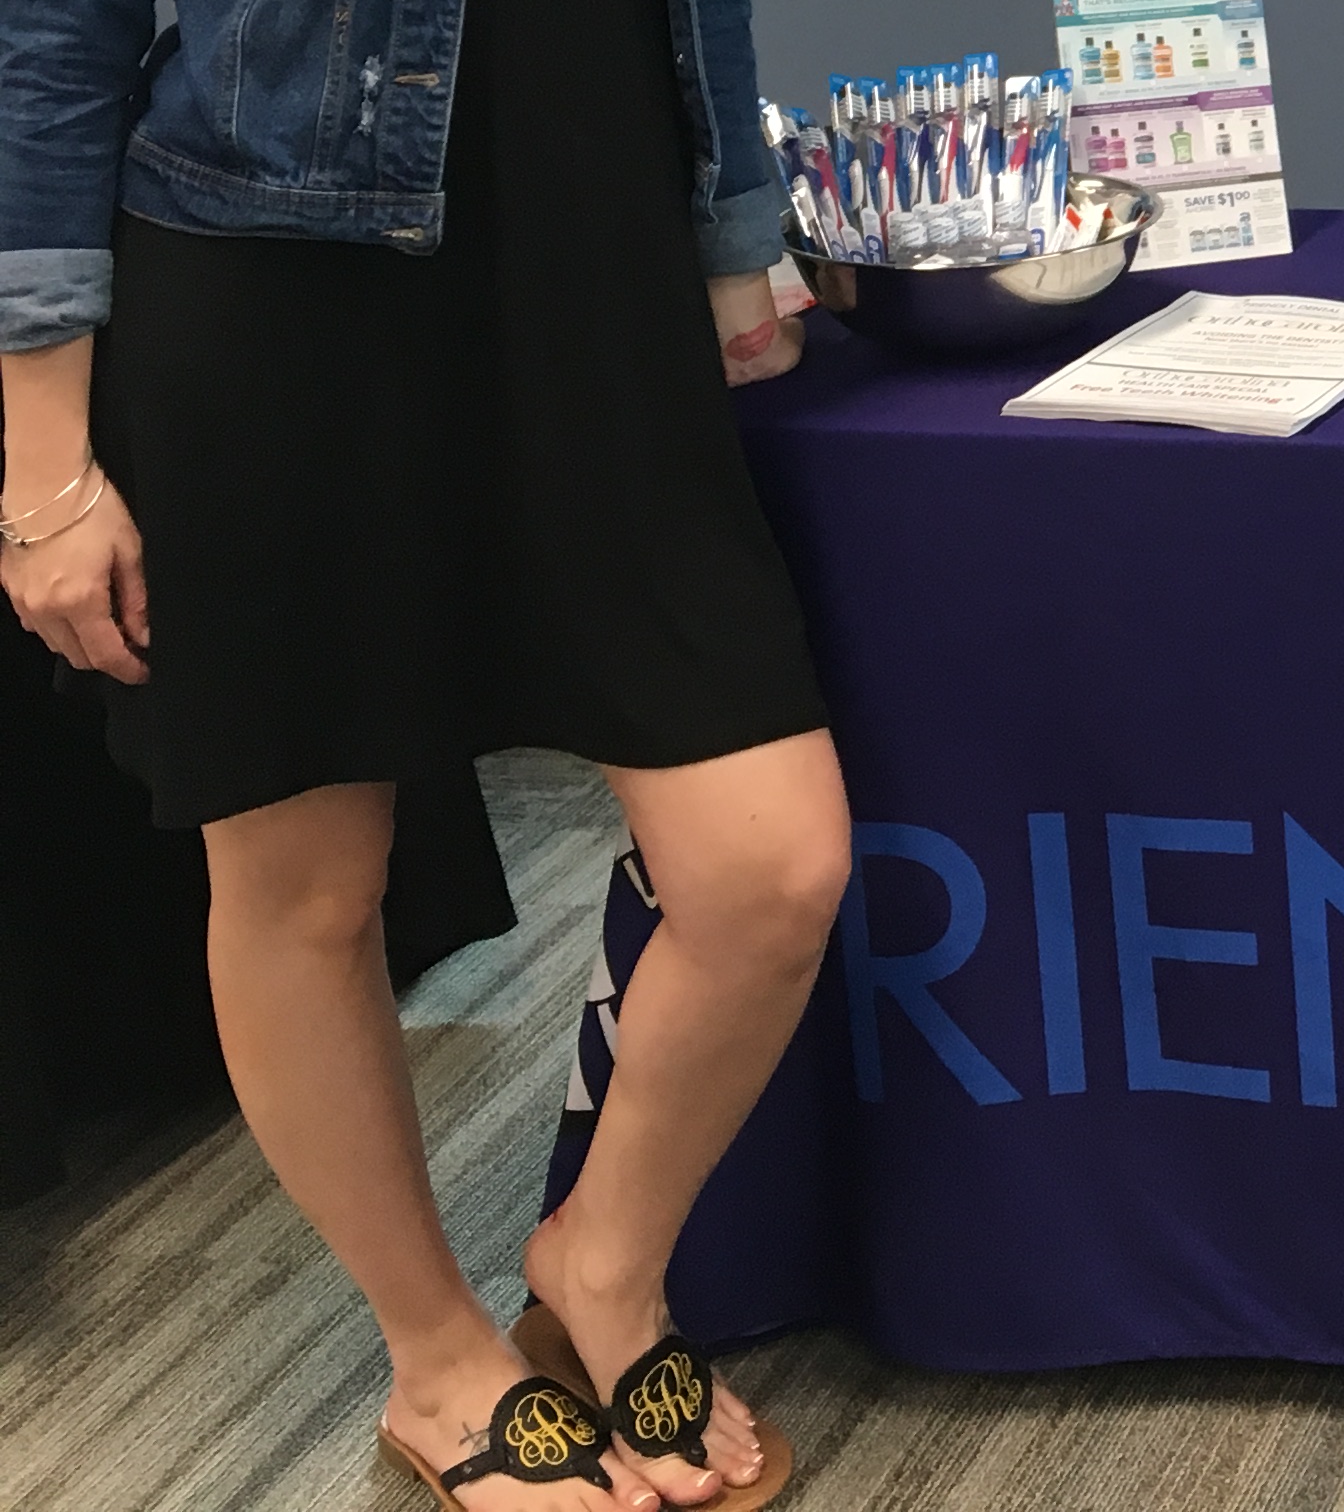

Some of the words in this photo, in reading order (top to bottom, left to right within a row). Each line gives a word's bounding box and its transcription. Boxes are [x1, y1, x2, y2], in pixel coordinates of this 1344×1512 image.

[1184, 193, 1216, 208] SAVE
[1260, 333, 1284, 341] THE
[1069, 383, 1114, 393] Free
[1119, 386, 1174, 396] Teeth
[1118, 379, 1174, 388] HEALTH
[1176, 382, 1210, 390] FAIR
[1212, 384, 1269, 393] SPECIAL
